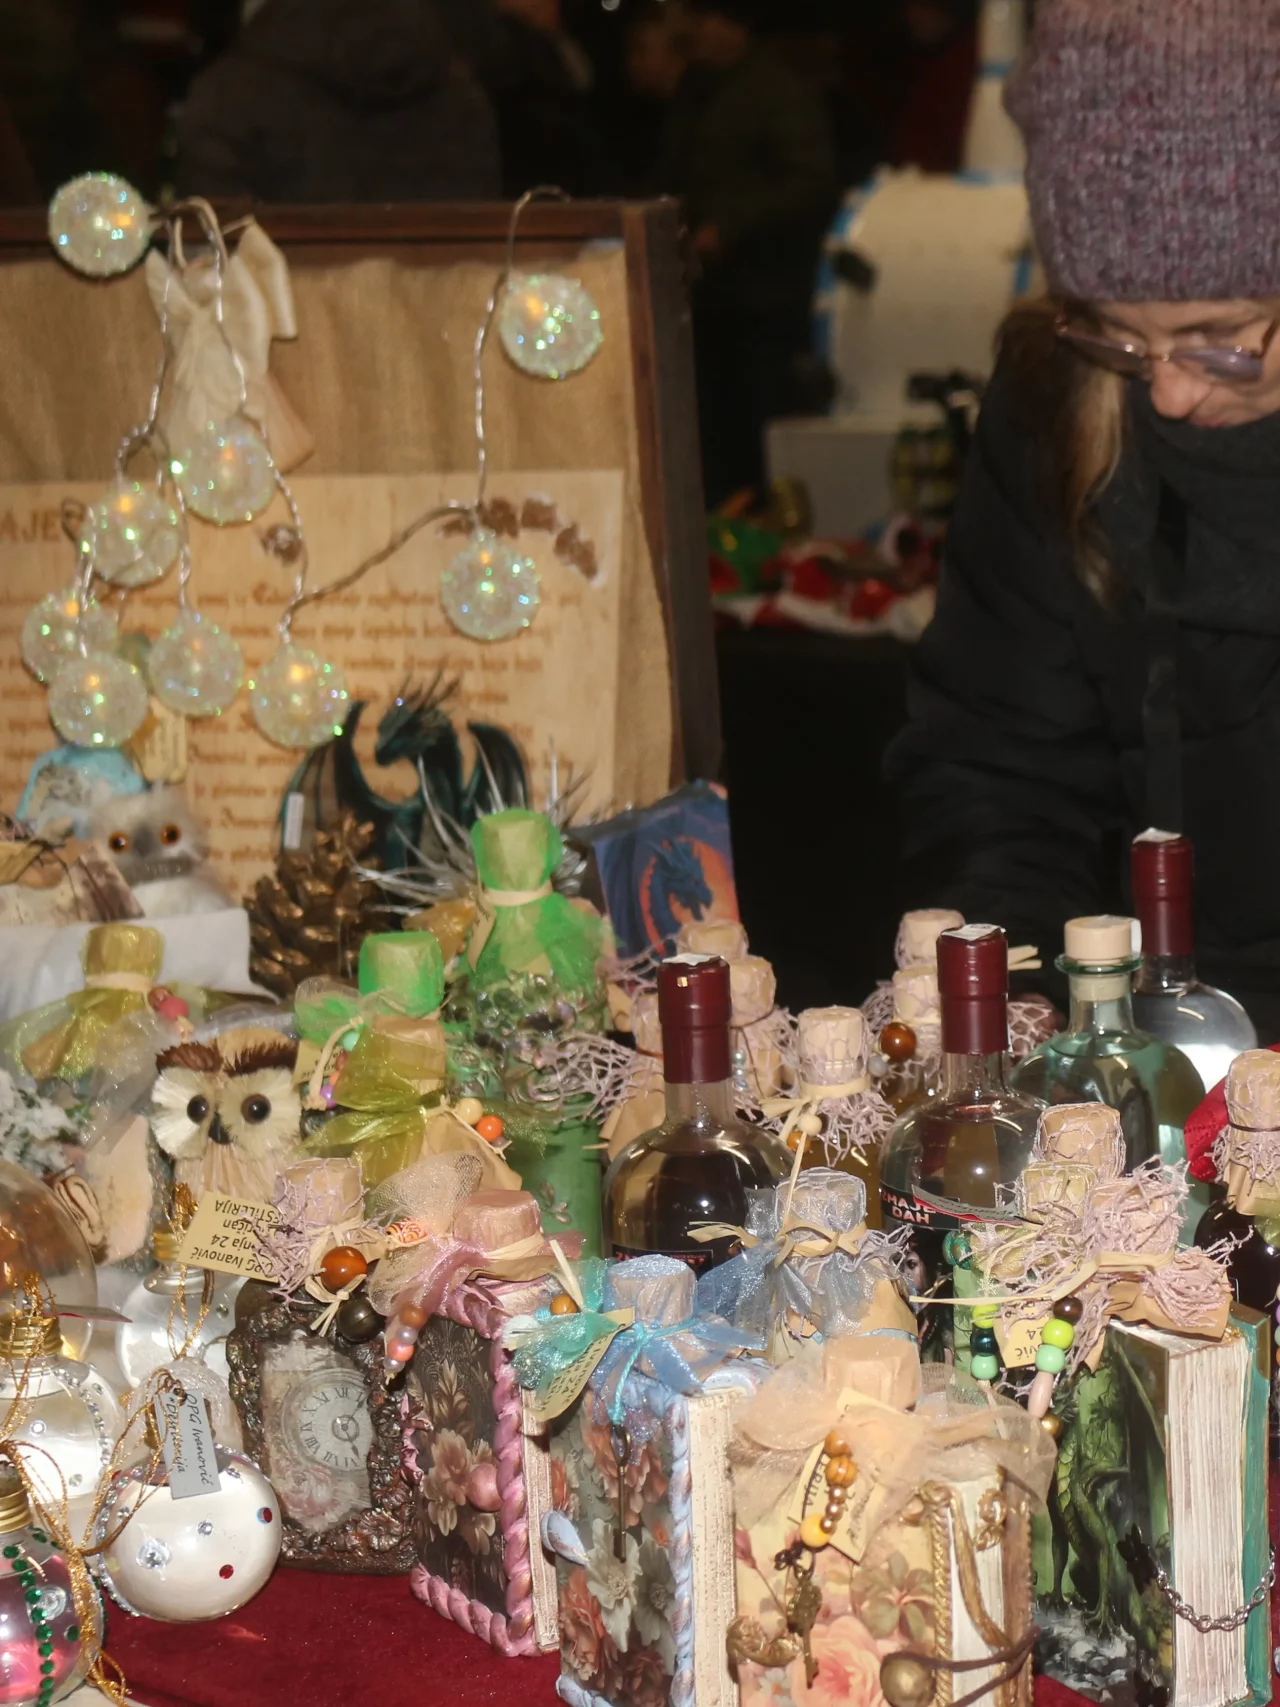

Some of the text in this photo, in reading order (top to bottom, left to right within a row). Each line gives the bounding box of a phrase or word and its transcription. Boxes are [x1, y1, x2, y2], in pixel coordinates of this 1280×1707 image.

[891, 1206, 931, 1226] DAH
[211, 1233, 230, 1249] 24
[190, 1246, 244, 1270] Ivanović
